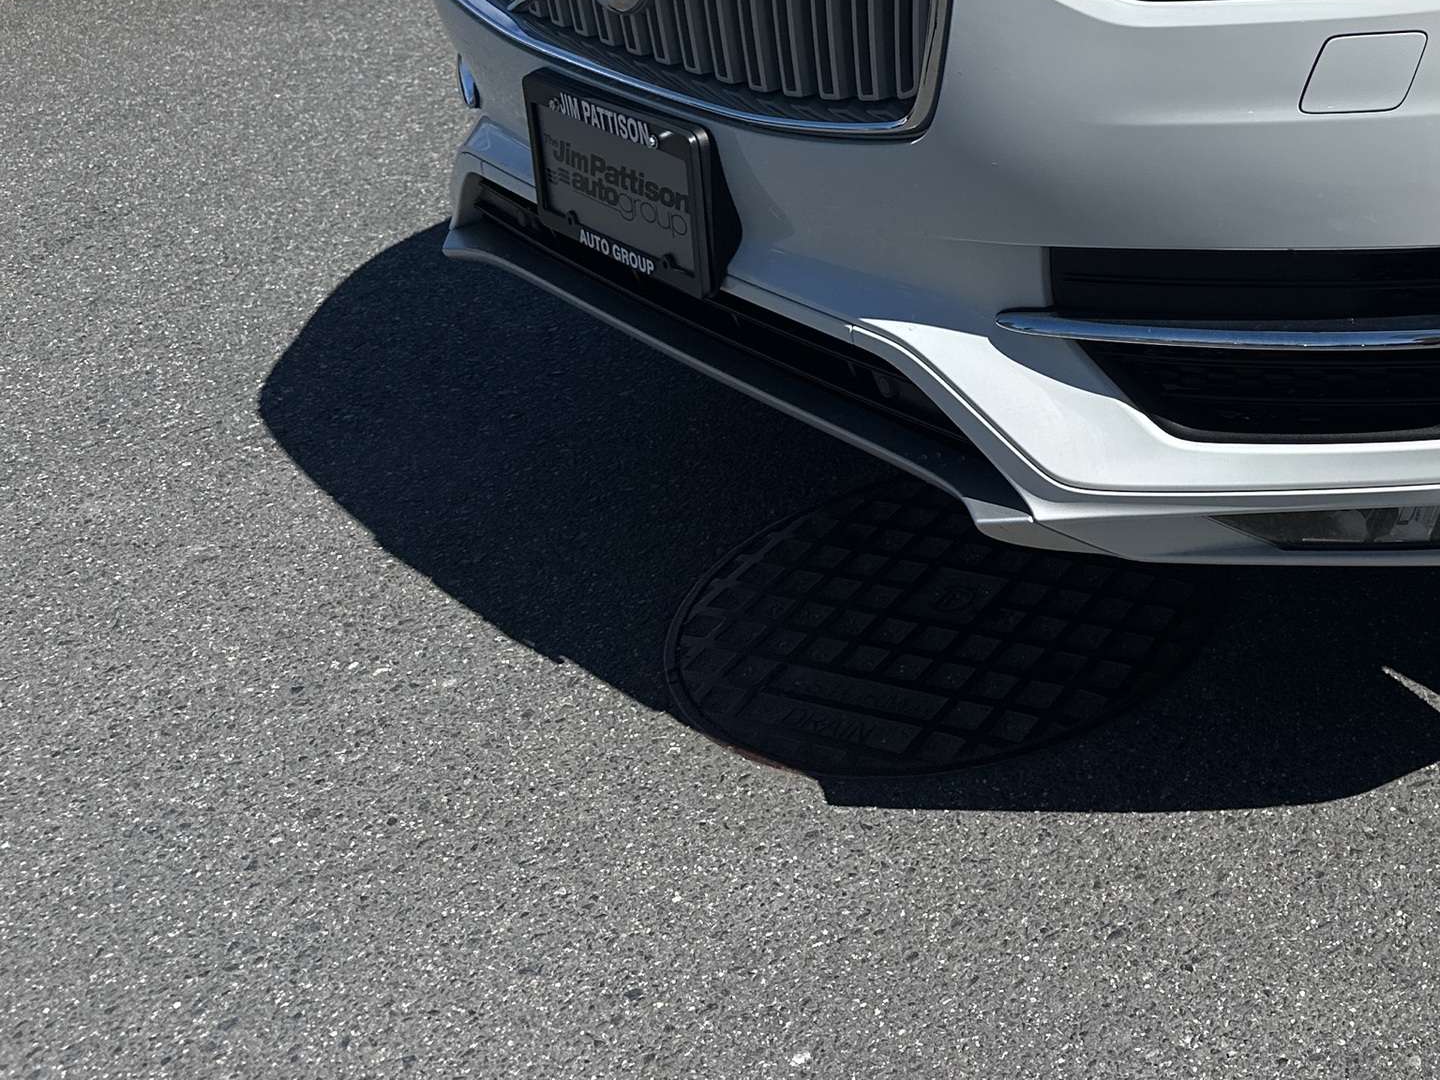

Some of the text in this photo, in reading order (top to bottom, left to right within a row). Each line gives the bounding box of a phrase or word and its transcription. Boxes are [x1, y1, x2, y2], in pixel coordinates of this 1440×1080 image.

[560, 91, 650, 148] JIM PATTISON
[579, 228, 655, 276] AUTO GROUP
